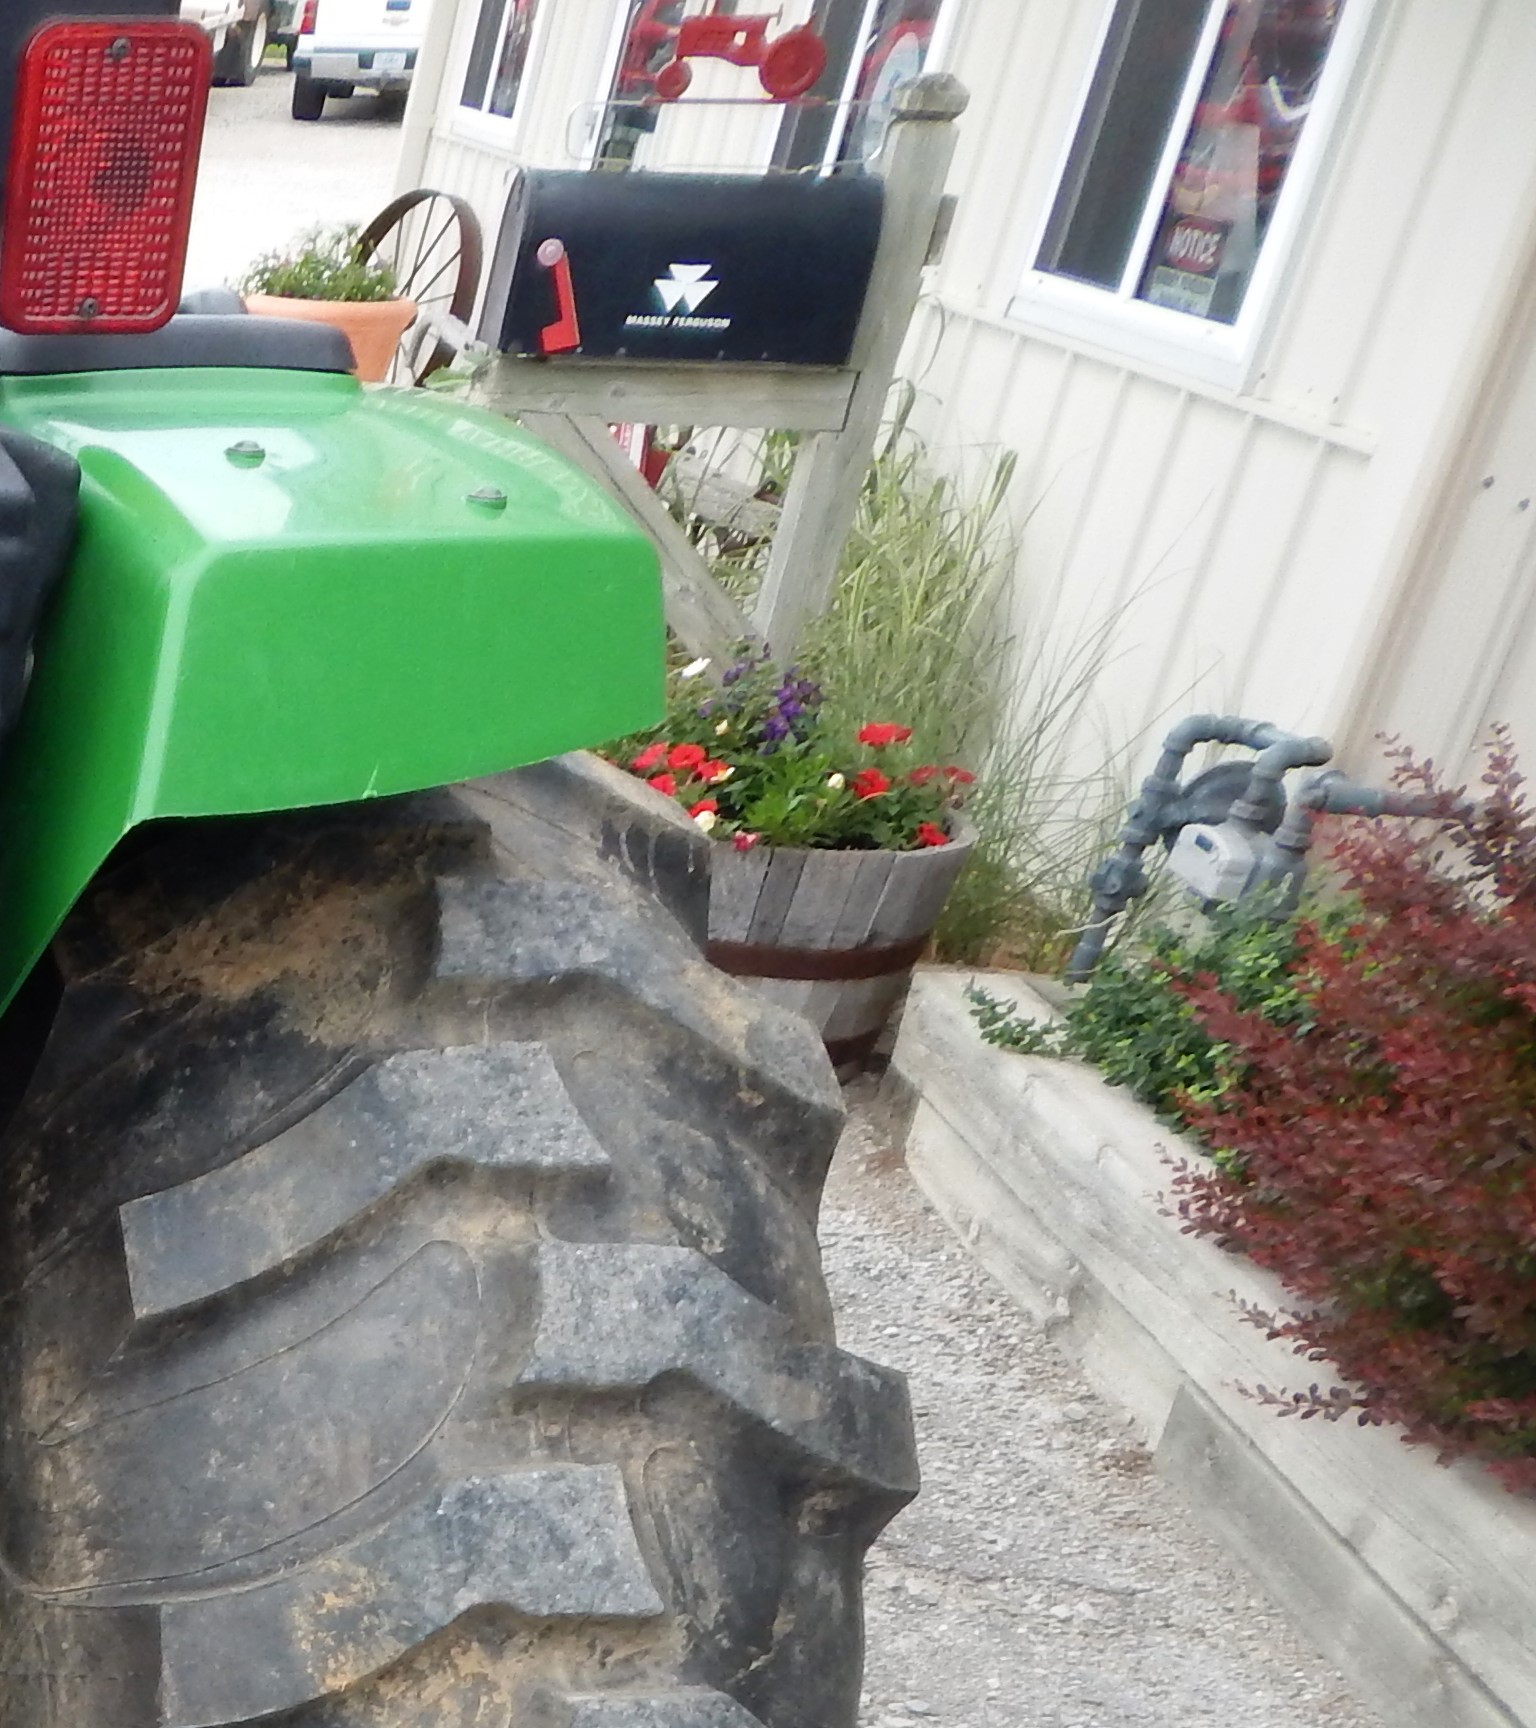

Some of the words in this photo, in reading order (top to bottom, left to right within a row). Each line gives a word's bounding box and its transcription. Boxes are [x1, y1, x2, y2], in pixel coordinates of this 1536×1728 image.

[1169, 226, 1222, 264] NOTICE
[625, 314, 671, 327] MASSEY
[672, 316, 731, 329] FERGUSON
